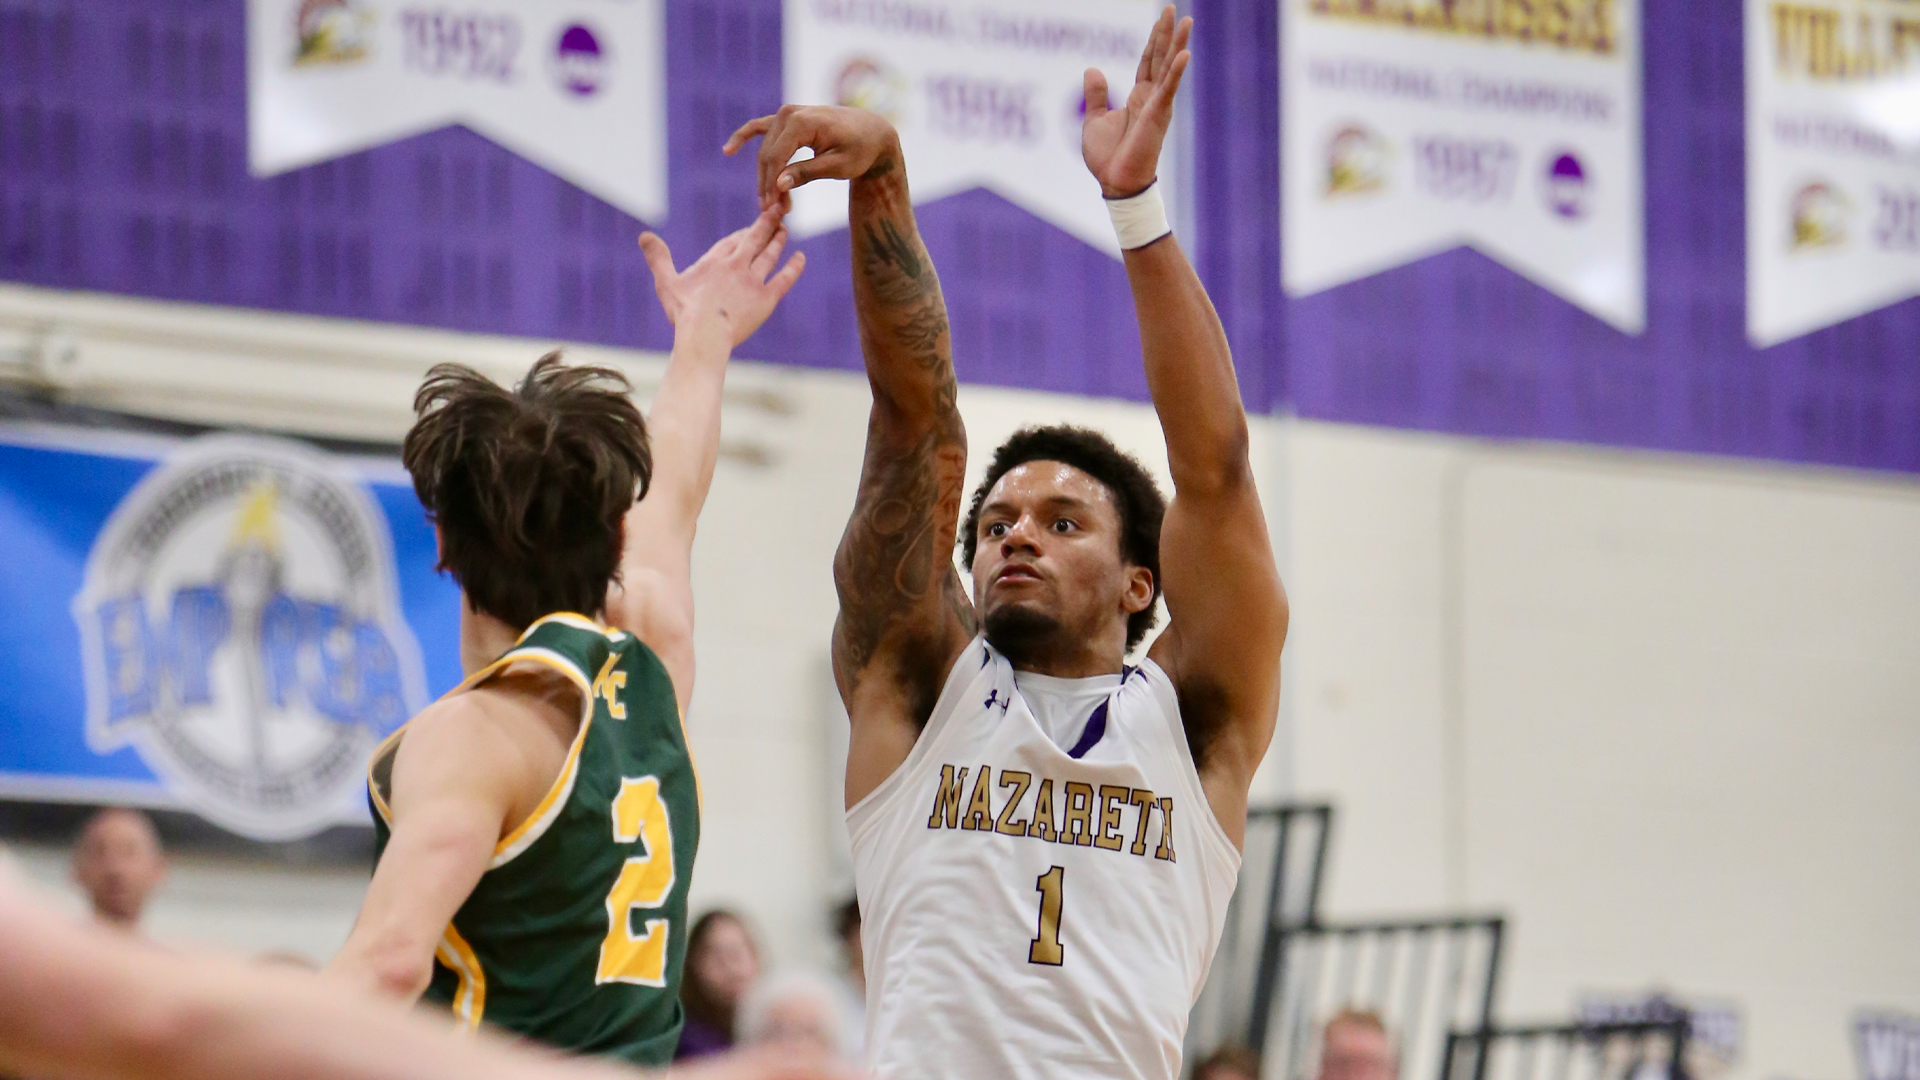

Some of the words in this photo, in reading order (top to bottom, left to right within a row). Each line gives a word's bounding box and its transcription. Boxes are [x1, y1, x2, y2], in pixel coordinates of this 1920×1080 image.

[397, 10, 523, 86] 1992
[927, 764, 1177, 864] NAZARETH
[595, 775, 676, 988] 2
[1028, 865, 1065, 967] 1
